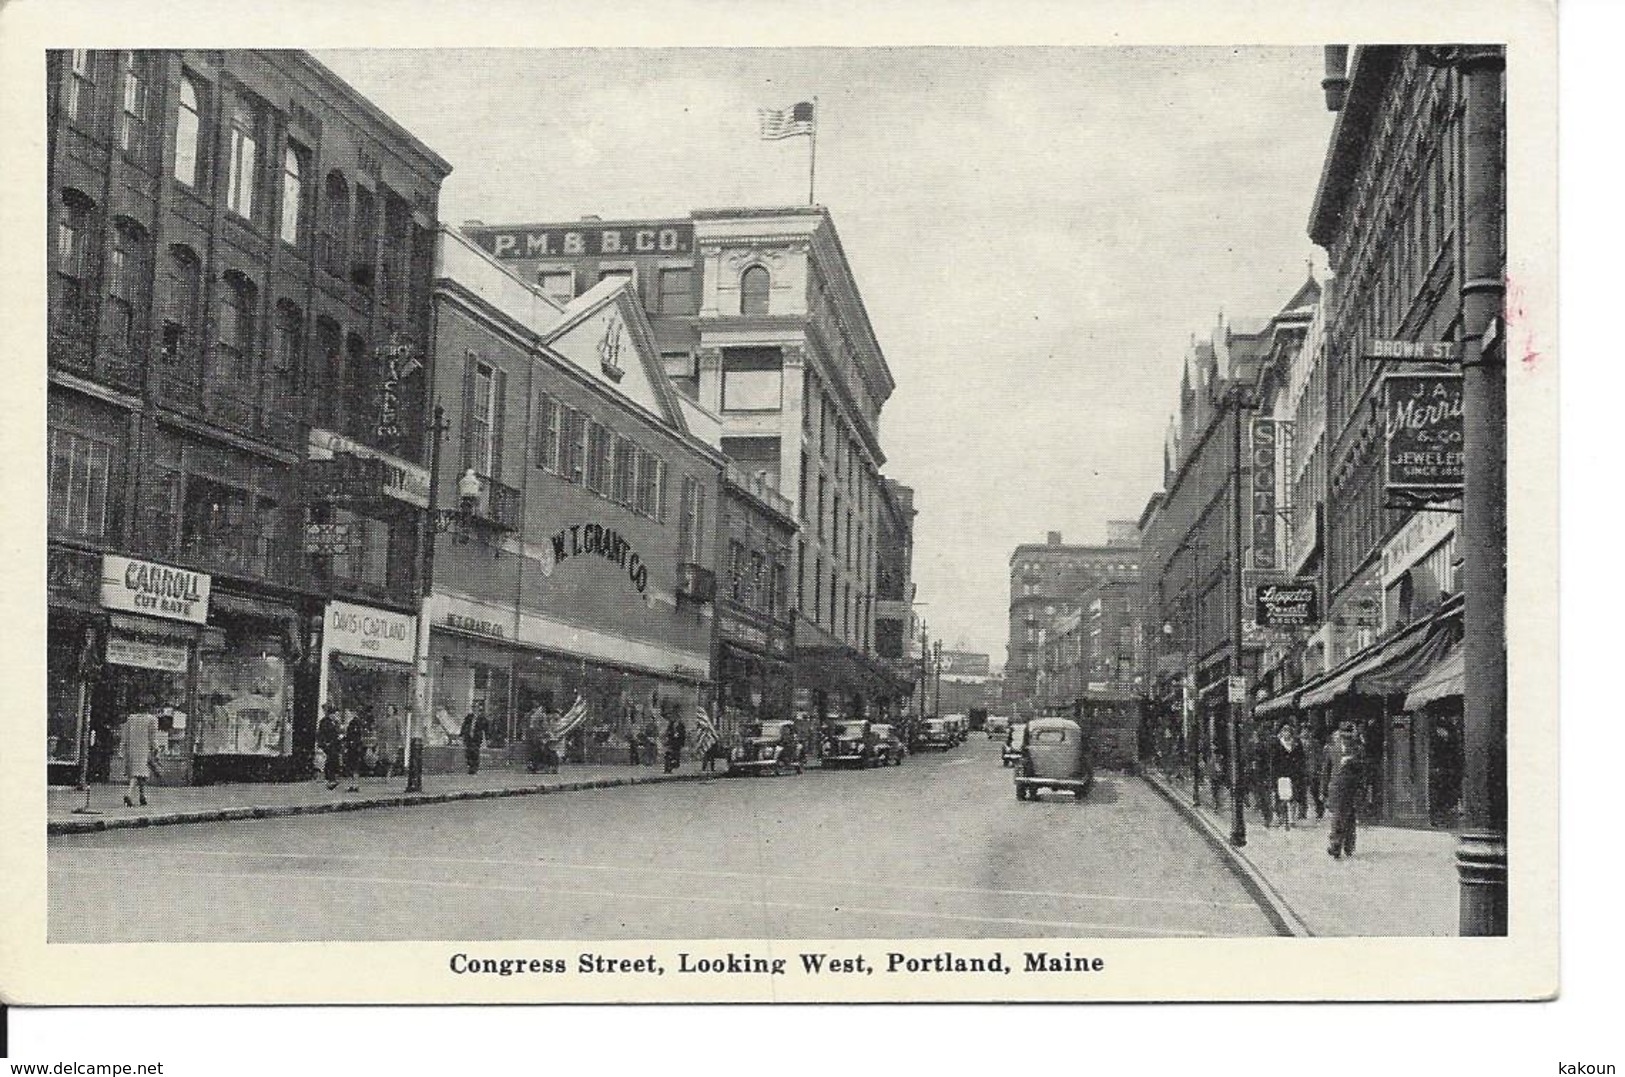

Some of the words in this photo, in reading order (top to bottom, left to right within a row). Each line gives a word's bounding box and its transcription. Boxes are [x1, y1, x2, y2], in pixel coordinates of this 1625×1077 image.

[1374, 340, 1424, 359] BROWN
[1385, 399, 1466, 440] Merri
[583, 523, 631, 570] GRANT
[124, 561, 200, 603] CARROLL
[133, 593, 158, 609] CUT
[160, 598, 193, 616] RATE
